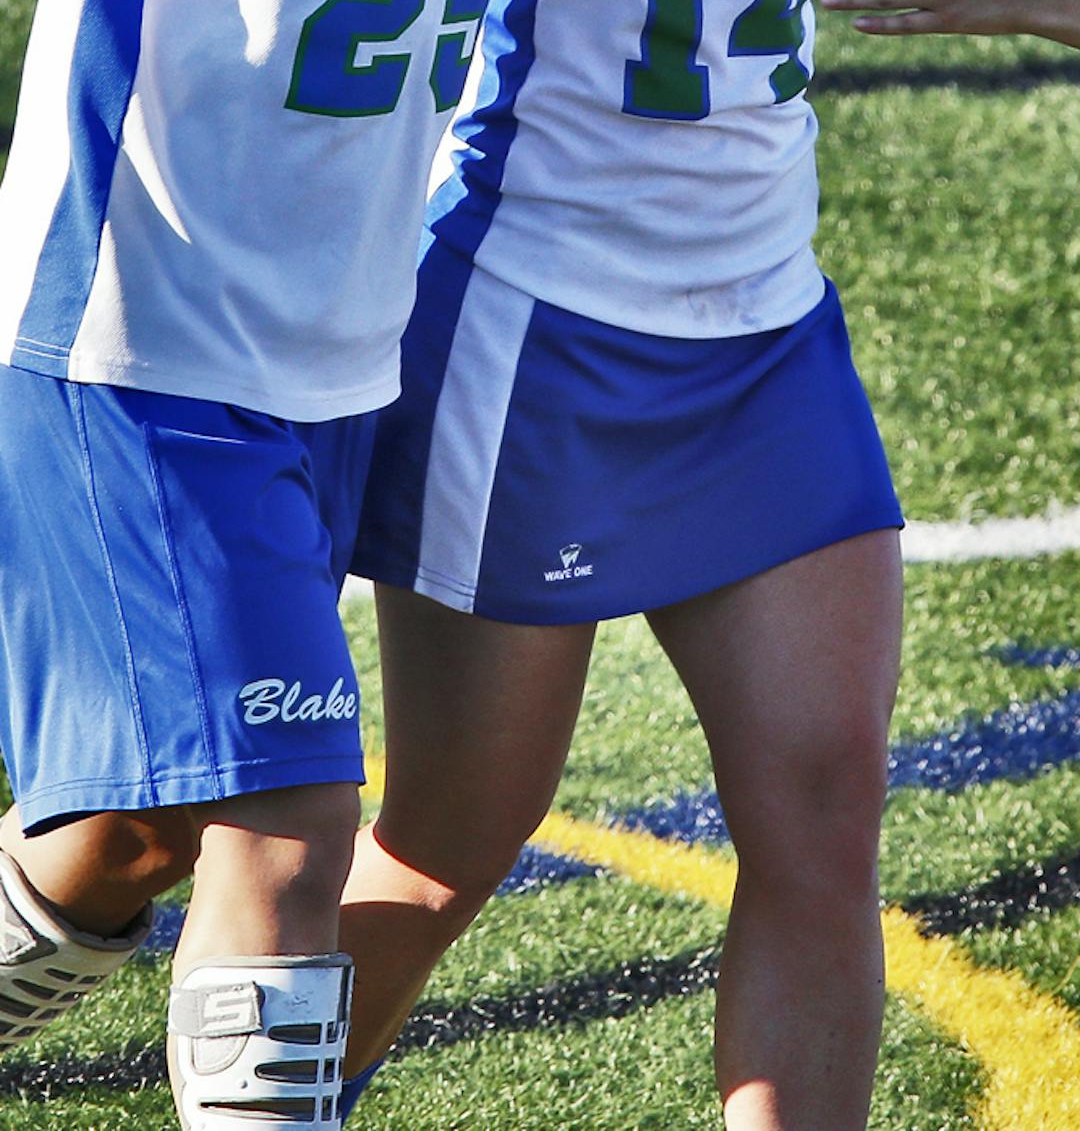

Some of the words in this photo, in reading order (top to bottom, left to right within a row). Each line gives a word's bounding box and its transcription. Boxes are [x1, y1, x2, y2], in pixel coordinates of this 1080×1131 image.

[543, 568, 572, 582] WAVE
[573, 564, 593, 577] ONE
[238, 677, 358, 726] Blake
